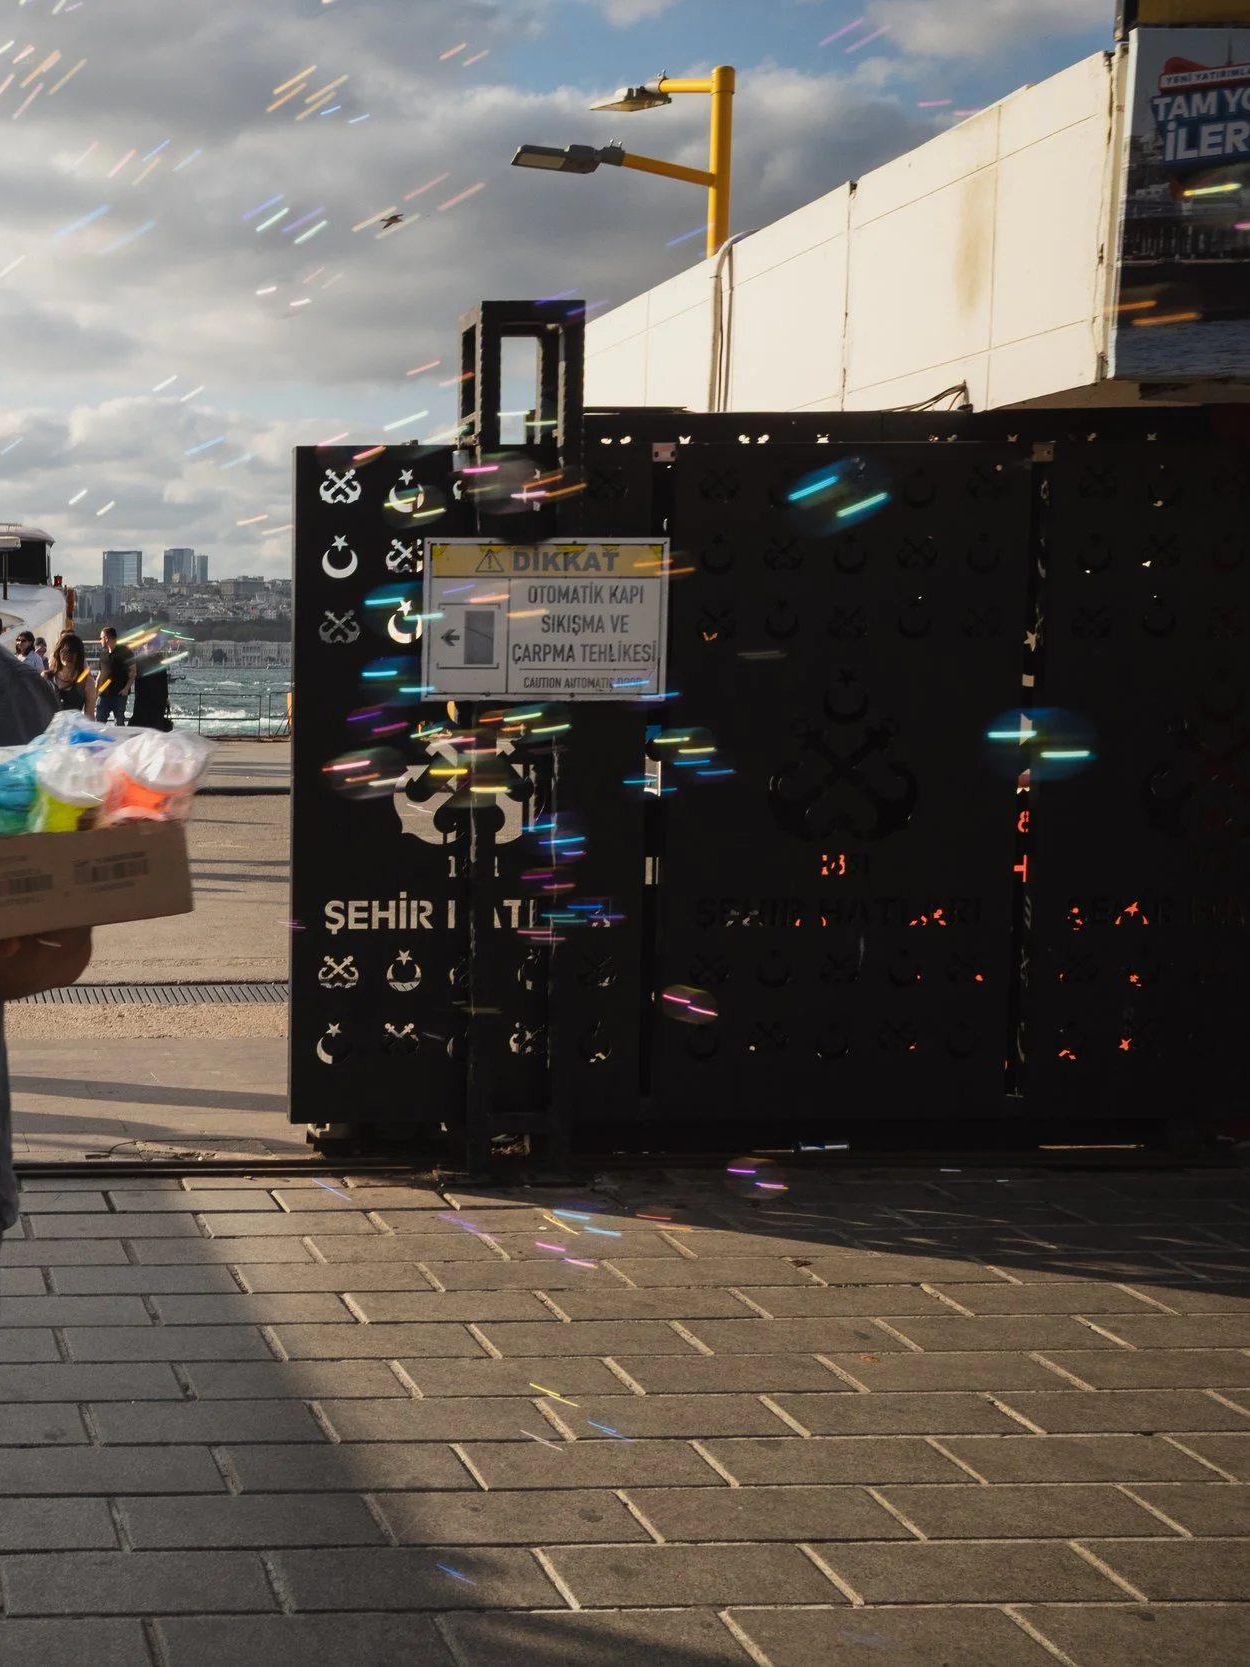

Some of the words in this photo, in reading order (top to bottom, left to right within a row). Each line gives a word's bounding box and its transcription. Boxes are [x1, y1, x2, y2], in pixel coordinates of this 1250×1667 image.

[1153, 91, 1218, 122] TAM
[1163, 120, 1250, 162] İLER
[512, 547, 620, 572] DİKKAT
[527, 582, 604, 605] OTOMATİK
[608, 584, 644, 604] KAPI
[541, 615, 605, 637] SIKIŞMA
[610, 614, 630, 634] VE
[512, 643, 576, 664] ÇARPMA
[580, 641, 657, 663] TEHLİKESİ
[523, 677, 562, 689] CAUTION
[564, 677, 614, 689] AUTOMATIC
[324, 891, 434, 935] ŞEHİR
